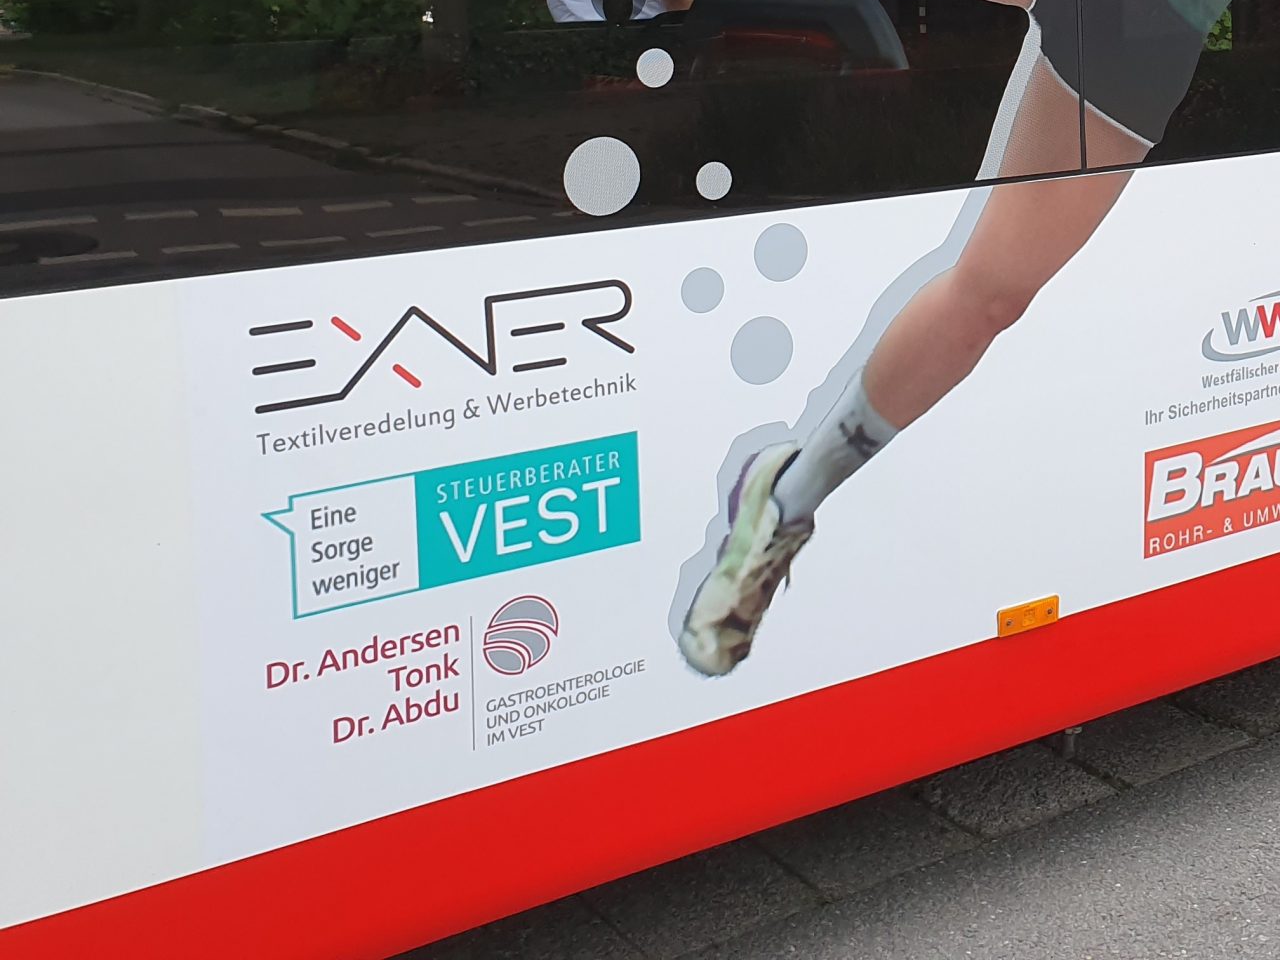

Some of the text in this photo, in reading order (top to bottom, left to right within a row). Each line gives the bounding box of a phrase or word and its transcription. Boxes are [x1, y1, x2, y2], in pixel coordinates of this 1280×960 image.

[249, 279, 635, 414] EXNER
[1202, 362, 1279, 389] Westfälischer
[256, 373, 637, 455] Textilveredelung & Werbetechnik
[1145, 410, 1164, 425] Ihr
[436, 451, 621, 504] STEUERBERATER
[311, 502, 357, 530] Eine
[439, 477, 622, 564] VEST
[1150, 525, 1213, 554] ROHR-
[1223, 517, 1233, 532] &
[311, 534, 374, 563] Sorge
[312, 561, 400, 596] weniger
[266, 623, 460, 689] Dr. Andersen
[388, 653, 460, 692] Tonk
[486, 659, 646, 713] GASTROENTEROLOGIE
[486, 684, 610, 730] UND ONKOLOGIE
[333, 689, 460, 744] Dr. Abdu
[487, 718, 544, 747] IM VEST
